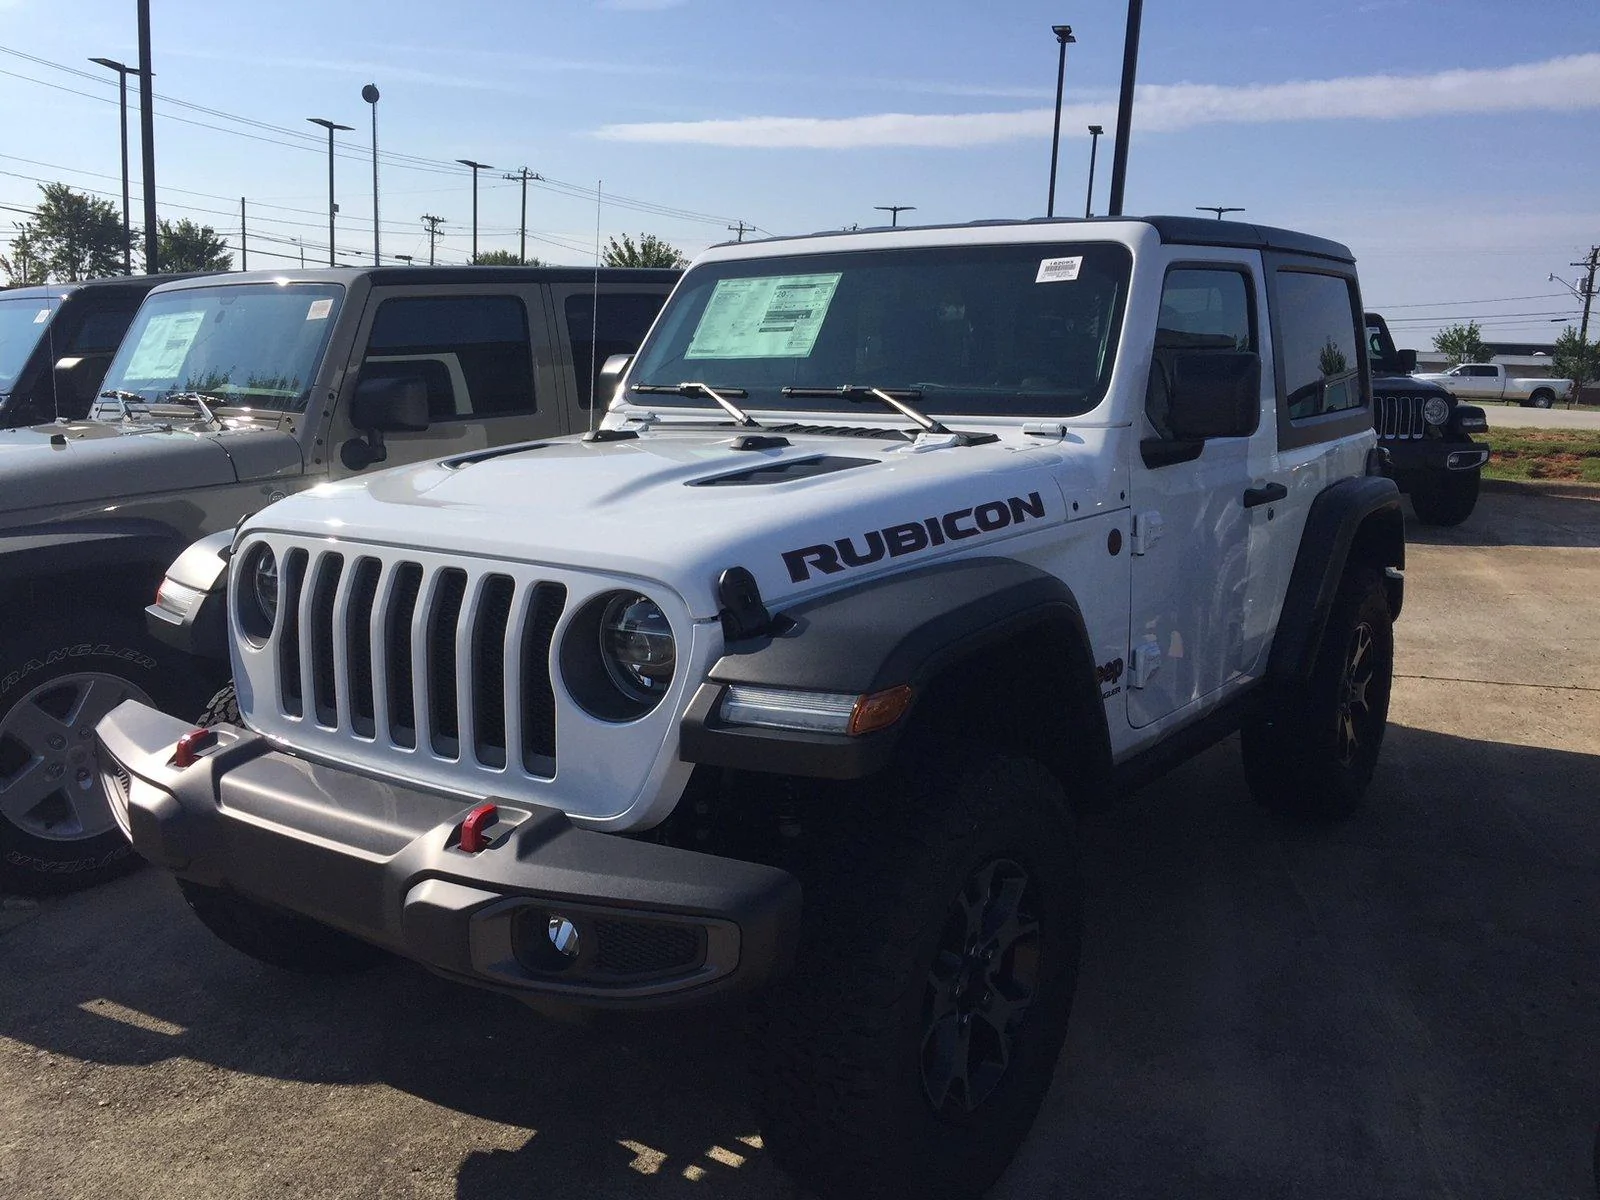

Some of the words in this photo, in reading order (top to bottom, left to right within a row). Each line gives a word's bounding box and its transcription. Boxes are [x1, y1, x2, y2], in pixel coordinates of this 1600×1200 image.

[781, 492, 1046, 584] RUBICON
[1095, 657, 1124, 684] eep
[1102, 686, 1121, 699] GLER
